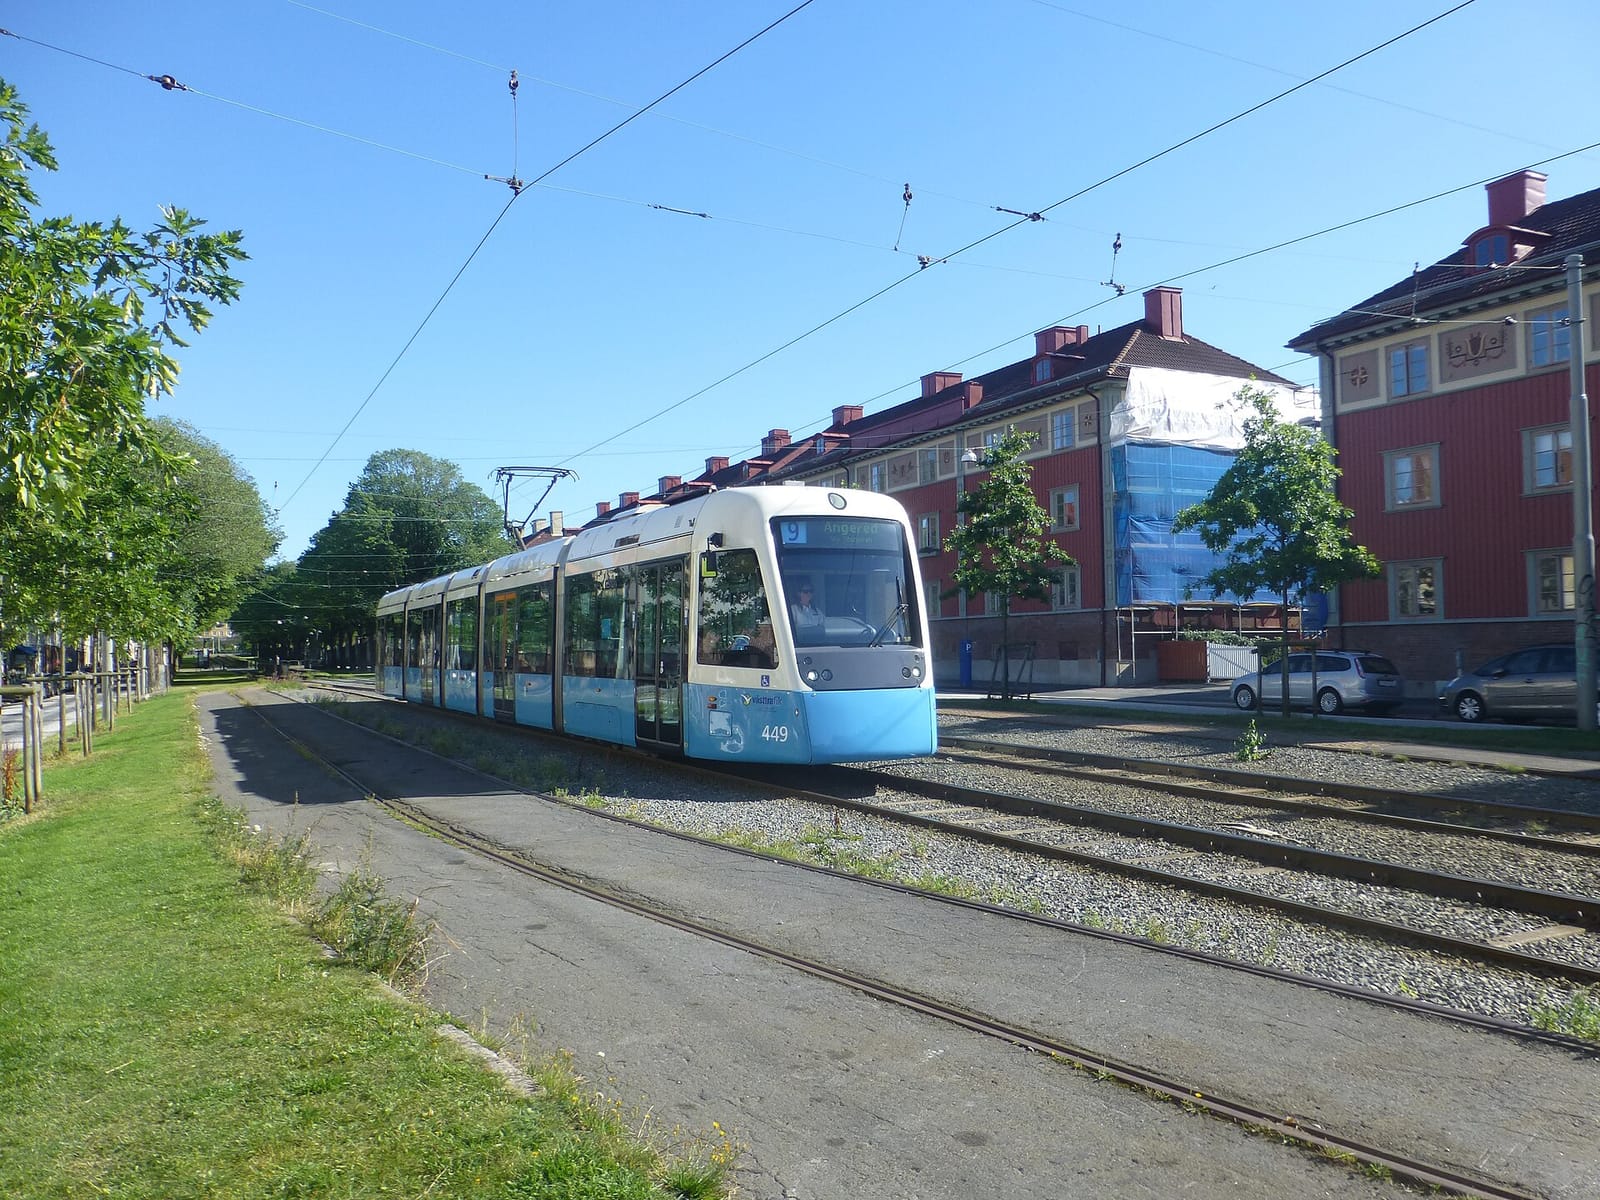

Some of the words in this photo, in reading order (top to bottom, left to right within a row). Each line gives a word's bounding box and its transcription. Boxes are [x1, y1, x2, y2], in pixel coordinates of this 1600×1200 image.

[788, 523, 799, 541] 9
[966, 643, 972, 653] P
[761, 724, 788, 743] 449
